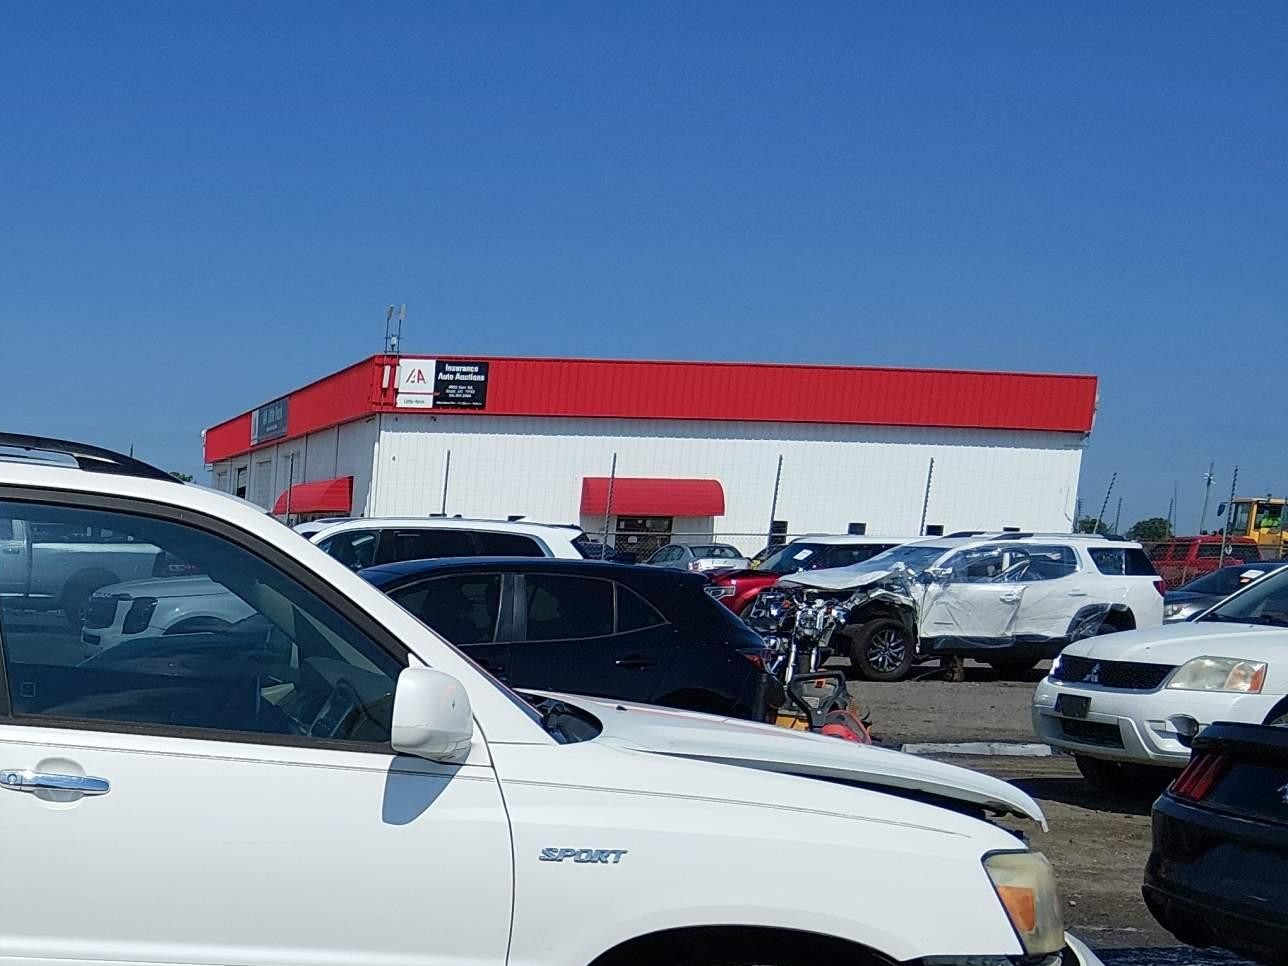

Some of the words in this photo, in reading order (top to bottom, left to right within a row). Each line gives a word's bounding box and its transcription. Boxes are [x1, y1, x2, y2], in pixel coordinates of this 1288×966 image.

[445, 364, 479, 372] Insurance
[438, 372, 454, 381] Auto
[455, 373, 485, 381] Auctions
[539, 847, 628, 864] SPORT
